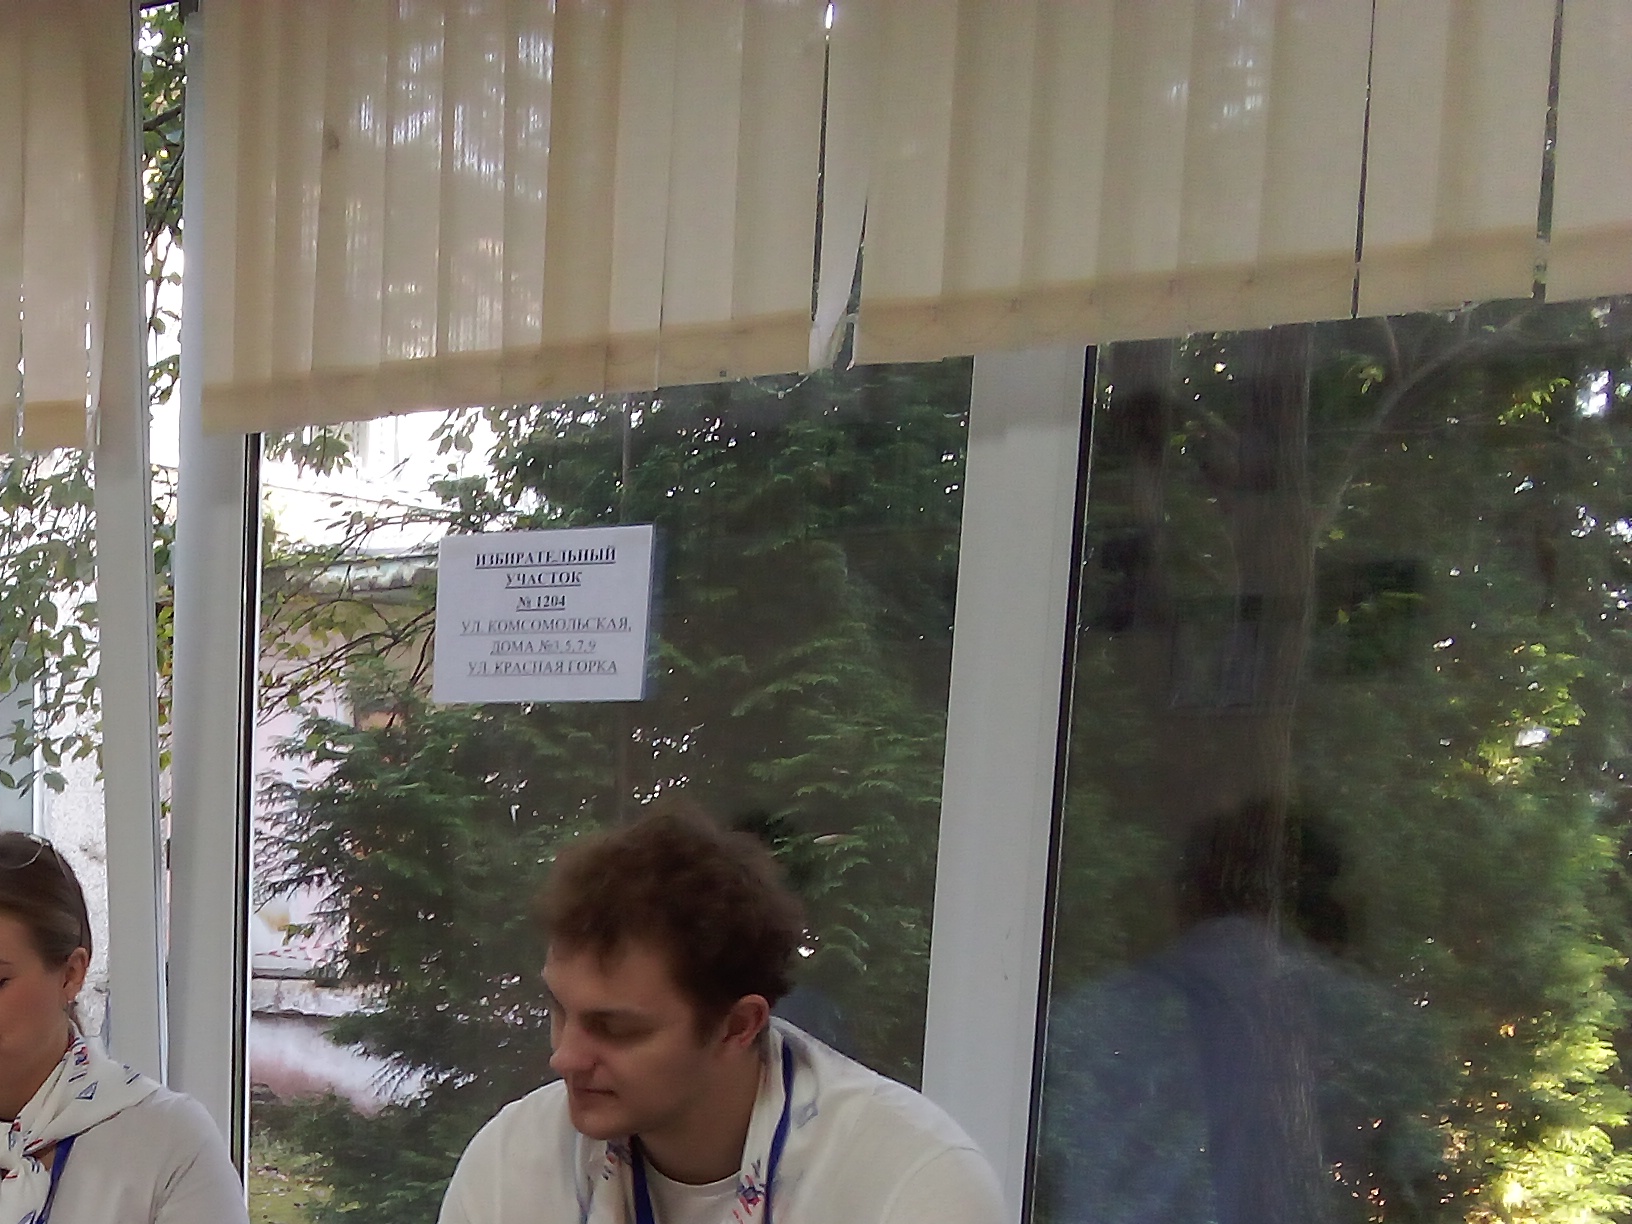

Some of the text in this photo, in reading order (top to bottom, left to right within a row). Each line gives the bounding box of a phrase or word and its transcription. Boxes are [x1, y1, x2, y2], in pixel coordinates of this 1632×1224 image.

[475, 545, 616, 568] ИЗБИРАТЕЛЬНЫЙ
[506, 571, 582, 588] УЧАСТОК
[537, 594, 566, 609] 1204
[490, 639, 534, 655] ДОМА
[495, 660, 564, 675] КРАСНАЯ
[568, 659, 618, 675] ГОРКА
